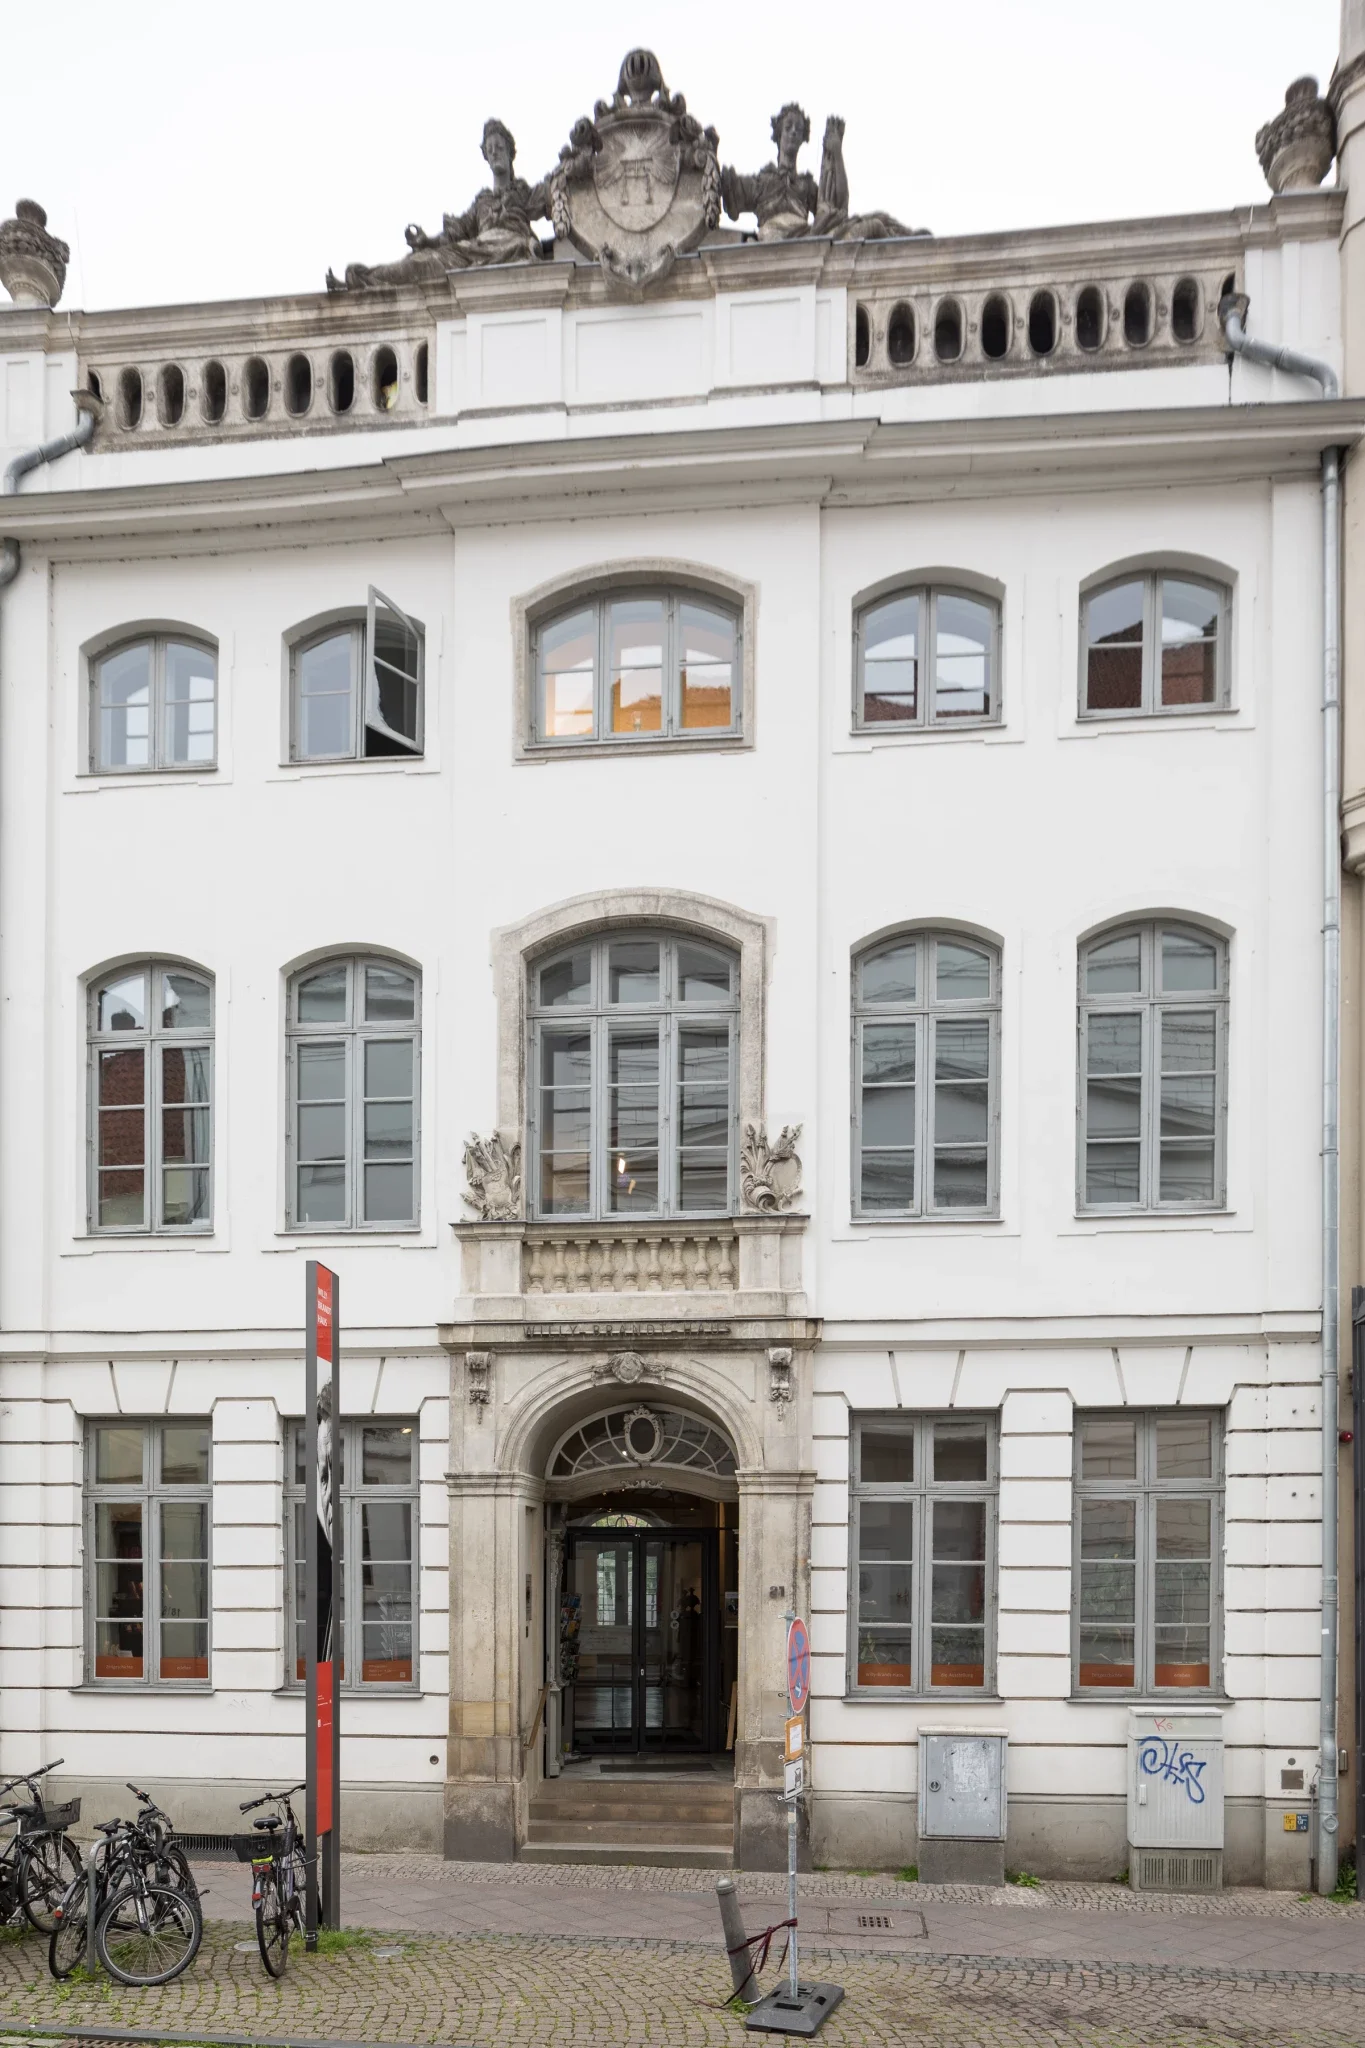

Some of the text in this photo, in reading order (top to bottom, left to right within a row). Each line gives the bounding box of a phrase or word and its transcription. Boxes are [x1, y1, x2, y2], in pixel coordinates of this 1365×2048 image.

[317, 1286, 328, 1299] WILLY
[317, 1300, 332, 1316] BRANDT
[317, 1314, 328, 1327] HAUS
